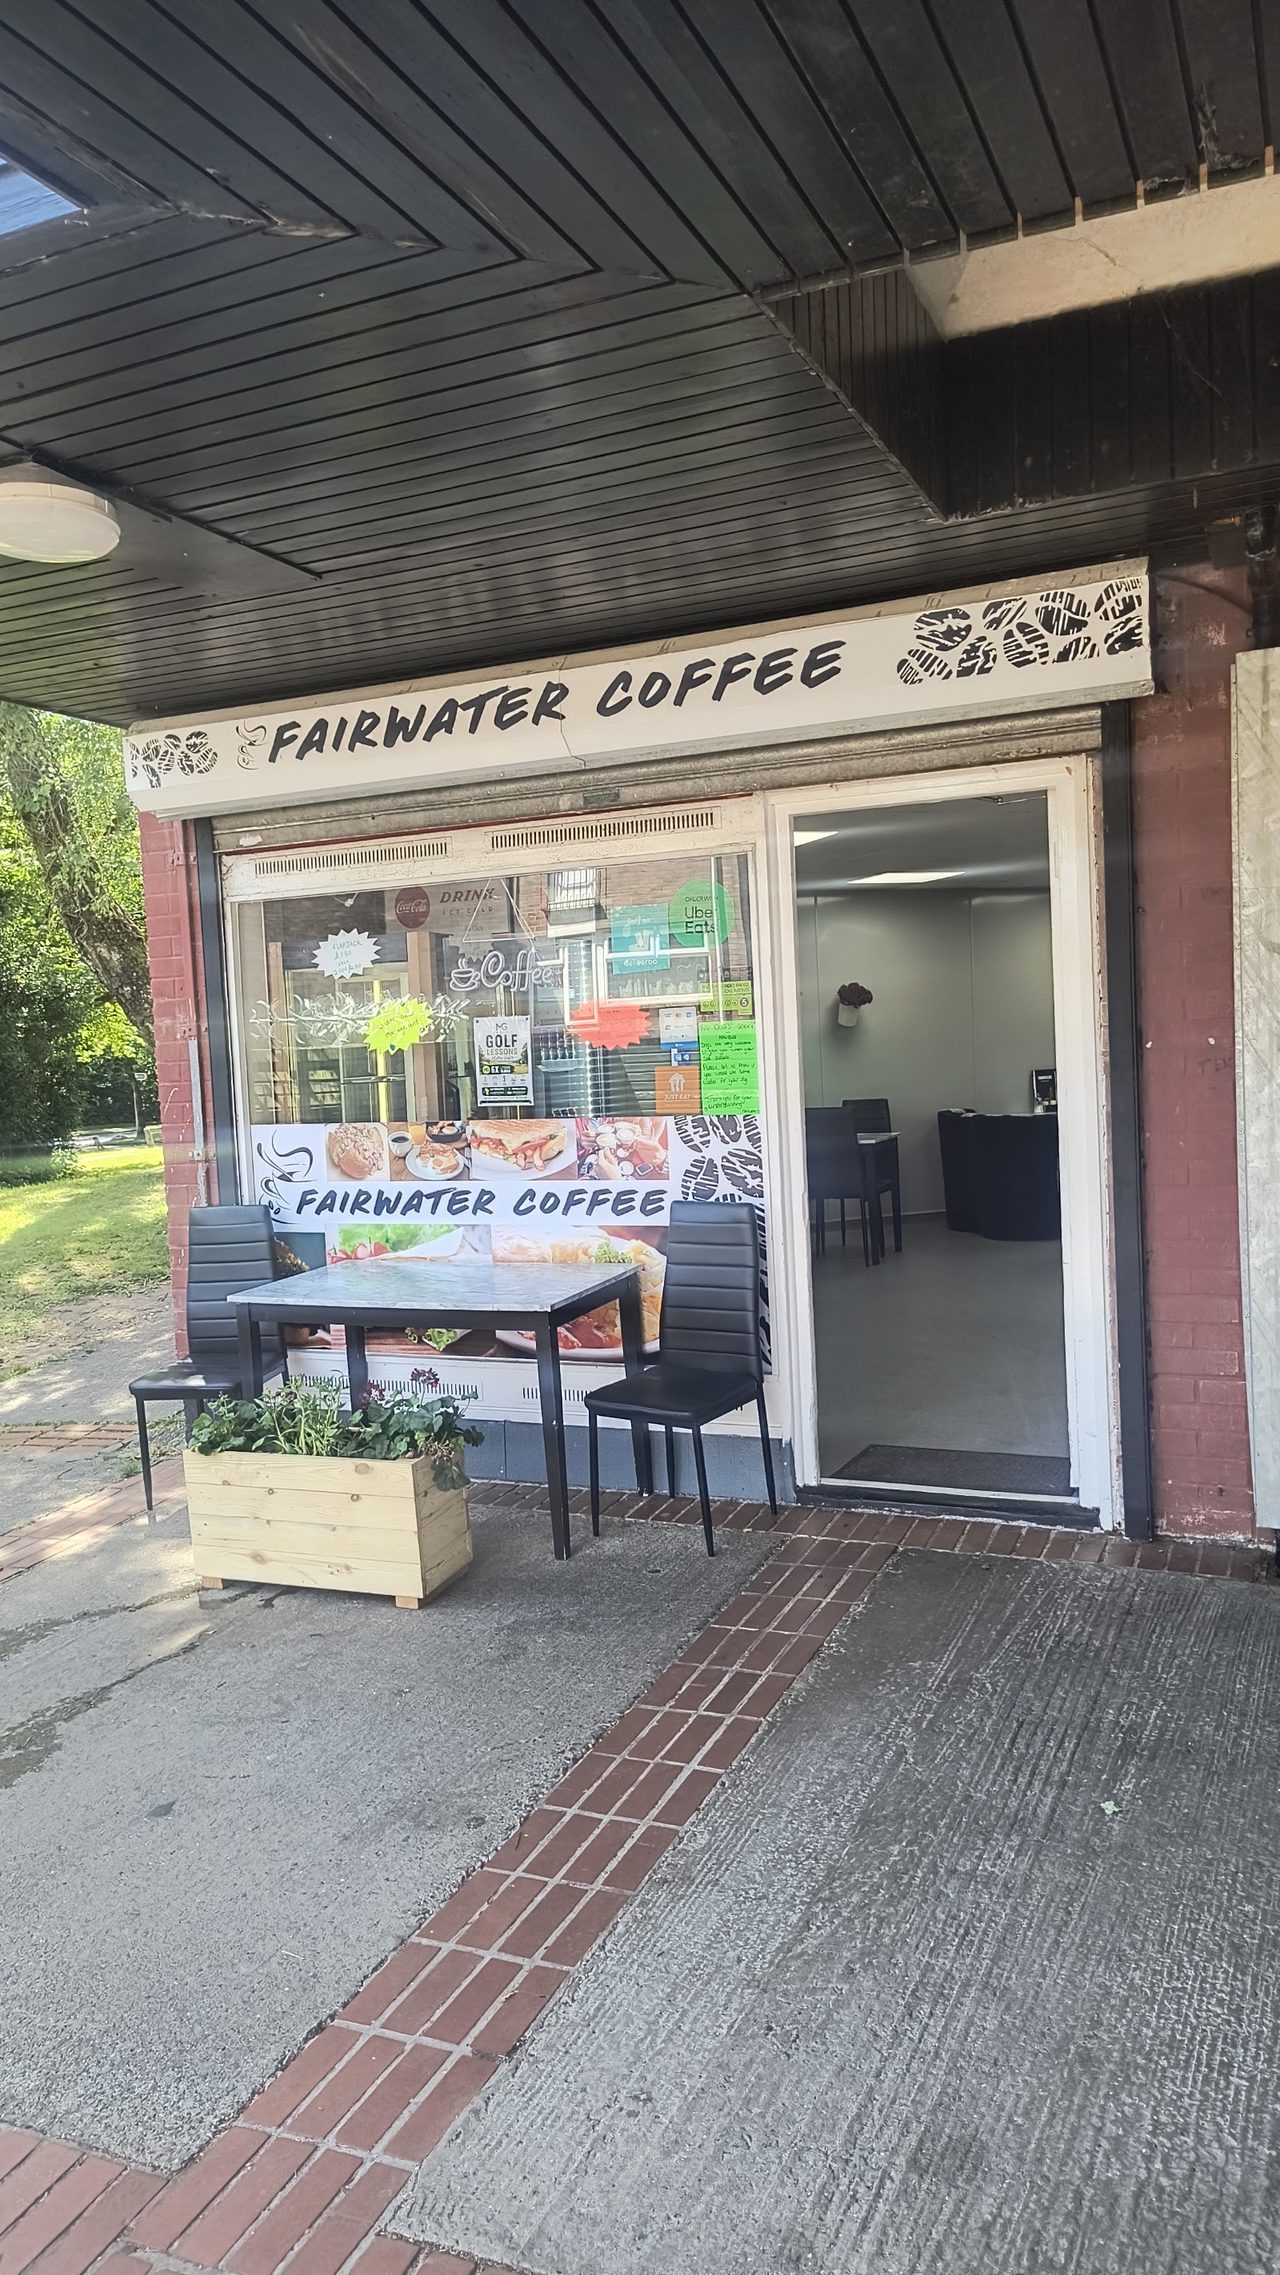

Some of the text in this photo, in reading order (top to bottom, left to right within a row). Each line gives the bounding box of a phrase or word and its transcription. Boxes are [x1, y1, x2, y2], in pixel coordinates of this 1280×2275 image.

[268, 640, 847, 763] FAIRWATER COFFEE
[440, 888, 495, 903] DRINK
[685, 906, 718, 918] Ube
[686, 921, 715, 933] Eats
[481, 950, 552, 992] Coffee
[486, 1034, 518, 1048] GOLF
[486, 1047, 518, 1056] LESSONS
[296, 1187, 669, 1217] FAIRWATER COFFEE
